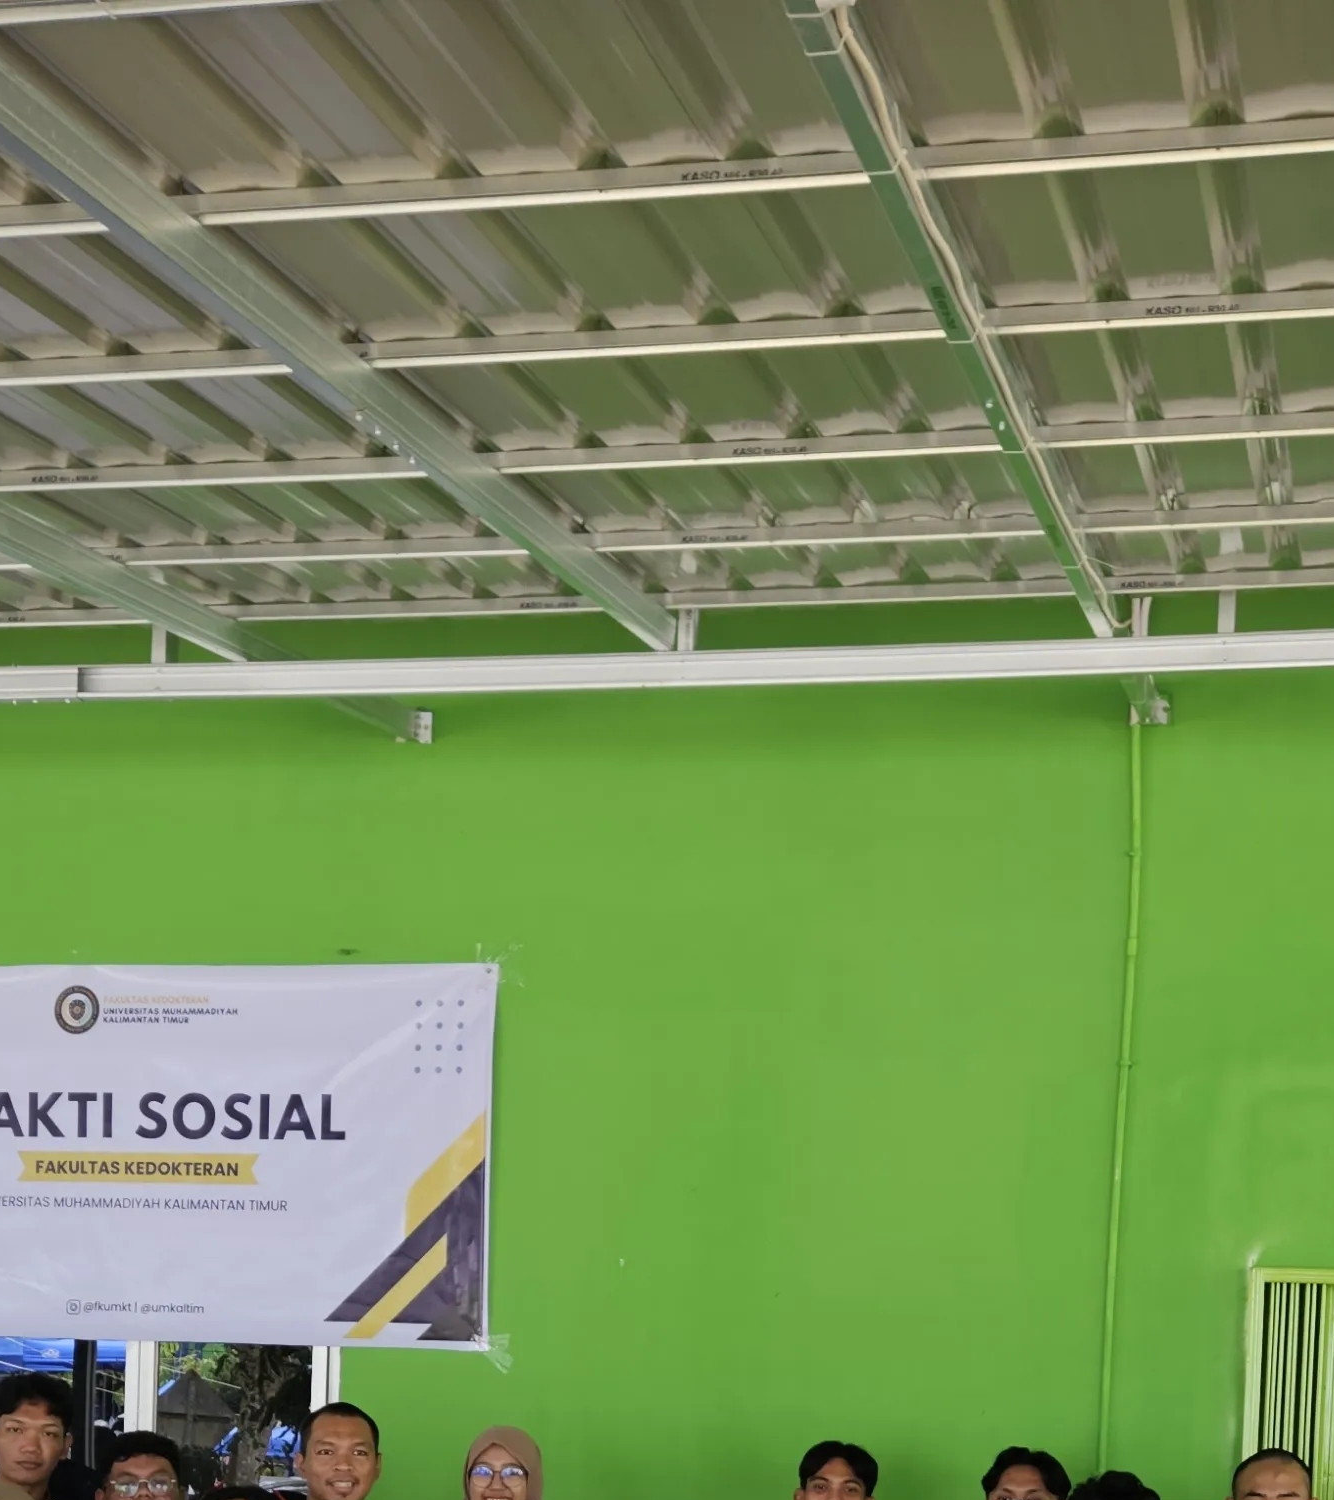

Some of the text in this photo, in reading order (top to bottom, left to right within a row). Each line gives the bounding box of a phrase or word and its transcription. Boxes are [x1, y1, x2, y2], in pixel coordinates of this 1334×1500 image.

[681, 170, 720, 182] KASO
[1145, 305, 1182, 316] KASO
[135, 1092, 346, 1142] SOSIAL
[35, 1159, 239, 1177] FAKULTAS KEDOKTERAN
[54, 1196, 160, 1209] MUHAMMADIYAH
[164, 1198, 245, 1211] KALIMANTAN
[250, 1199, 288, 1212] TIMUR
[83, 1301, 132, 1314] @fkumkt
[140, 1303, 204, 1315] @umkaltim
